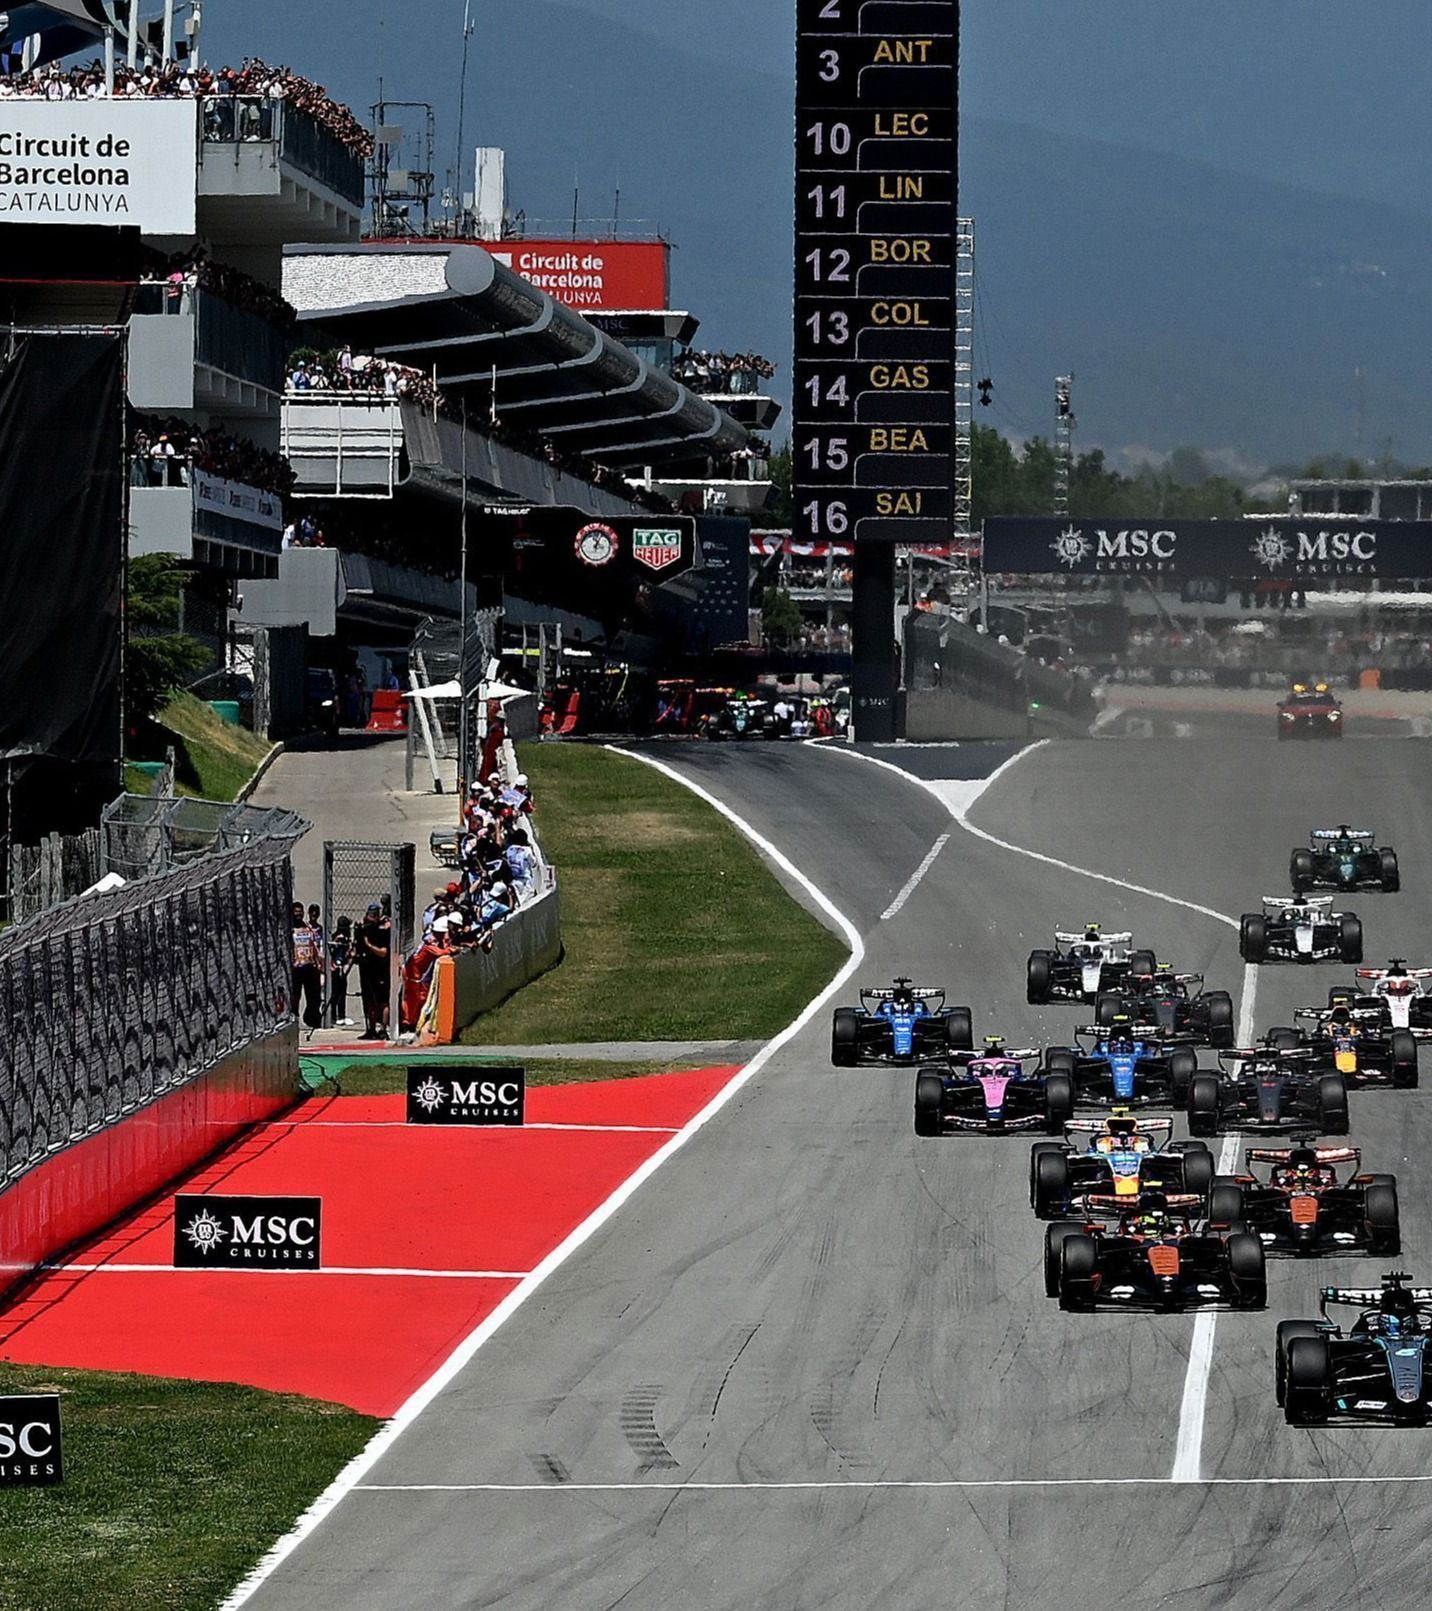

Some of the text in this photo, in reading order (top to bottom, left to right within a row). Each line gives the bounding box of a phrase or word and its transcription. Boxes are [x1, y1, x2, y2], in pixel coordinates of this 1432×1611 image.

[819, 0, 840, 18] 2
[818, 40, 933, 82] 3 ANT
[0, 132, 130, 157] Circuit de
[806, 113, 929, 156] 10 LEC
[0, 163, 129, 186] Barcelona
[0, 191, 129, 213] CATALUNYA
[806, 176, 923, 218] 11 LIN
[519, 252, 604, 271] Circuit de
[805, 239, 932, 282] 12 BOR
[806, 302, 929, 345] 13 COL
[805, 365, 929, 407] 14 GAS
[804, 428, 928, 470] 15 BEA
[803, 492, 921, 534] 16 SAI
[636, 531, 677, 544] TAG
[1095, 529, 1177, 558] MSC
[1296, 531, 1377, 561] MSC
[636, 547, 678, 565] HEUER
[450, 1081, 519, 1105] MSC
[230, 1216, 315, 1245] MSC
[229, 1248, 315, 1260] CRUISES
